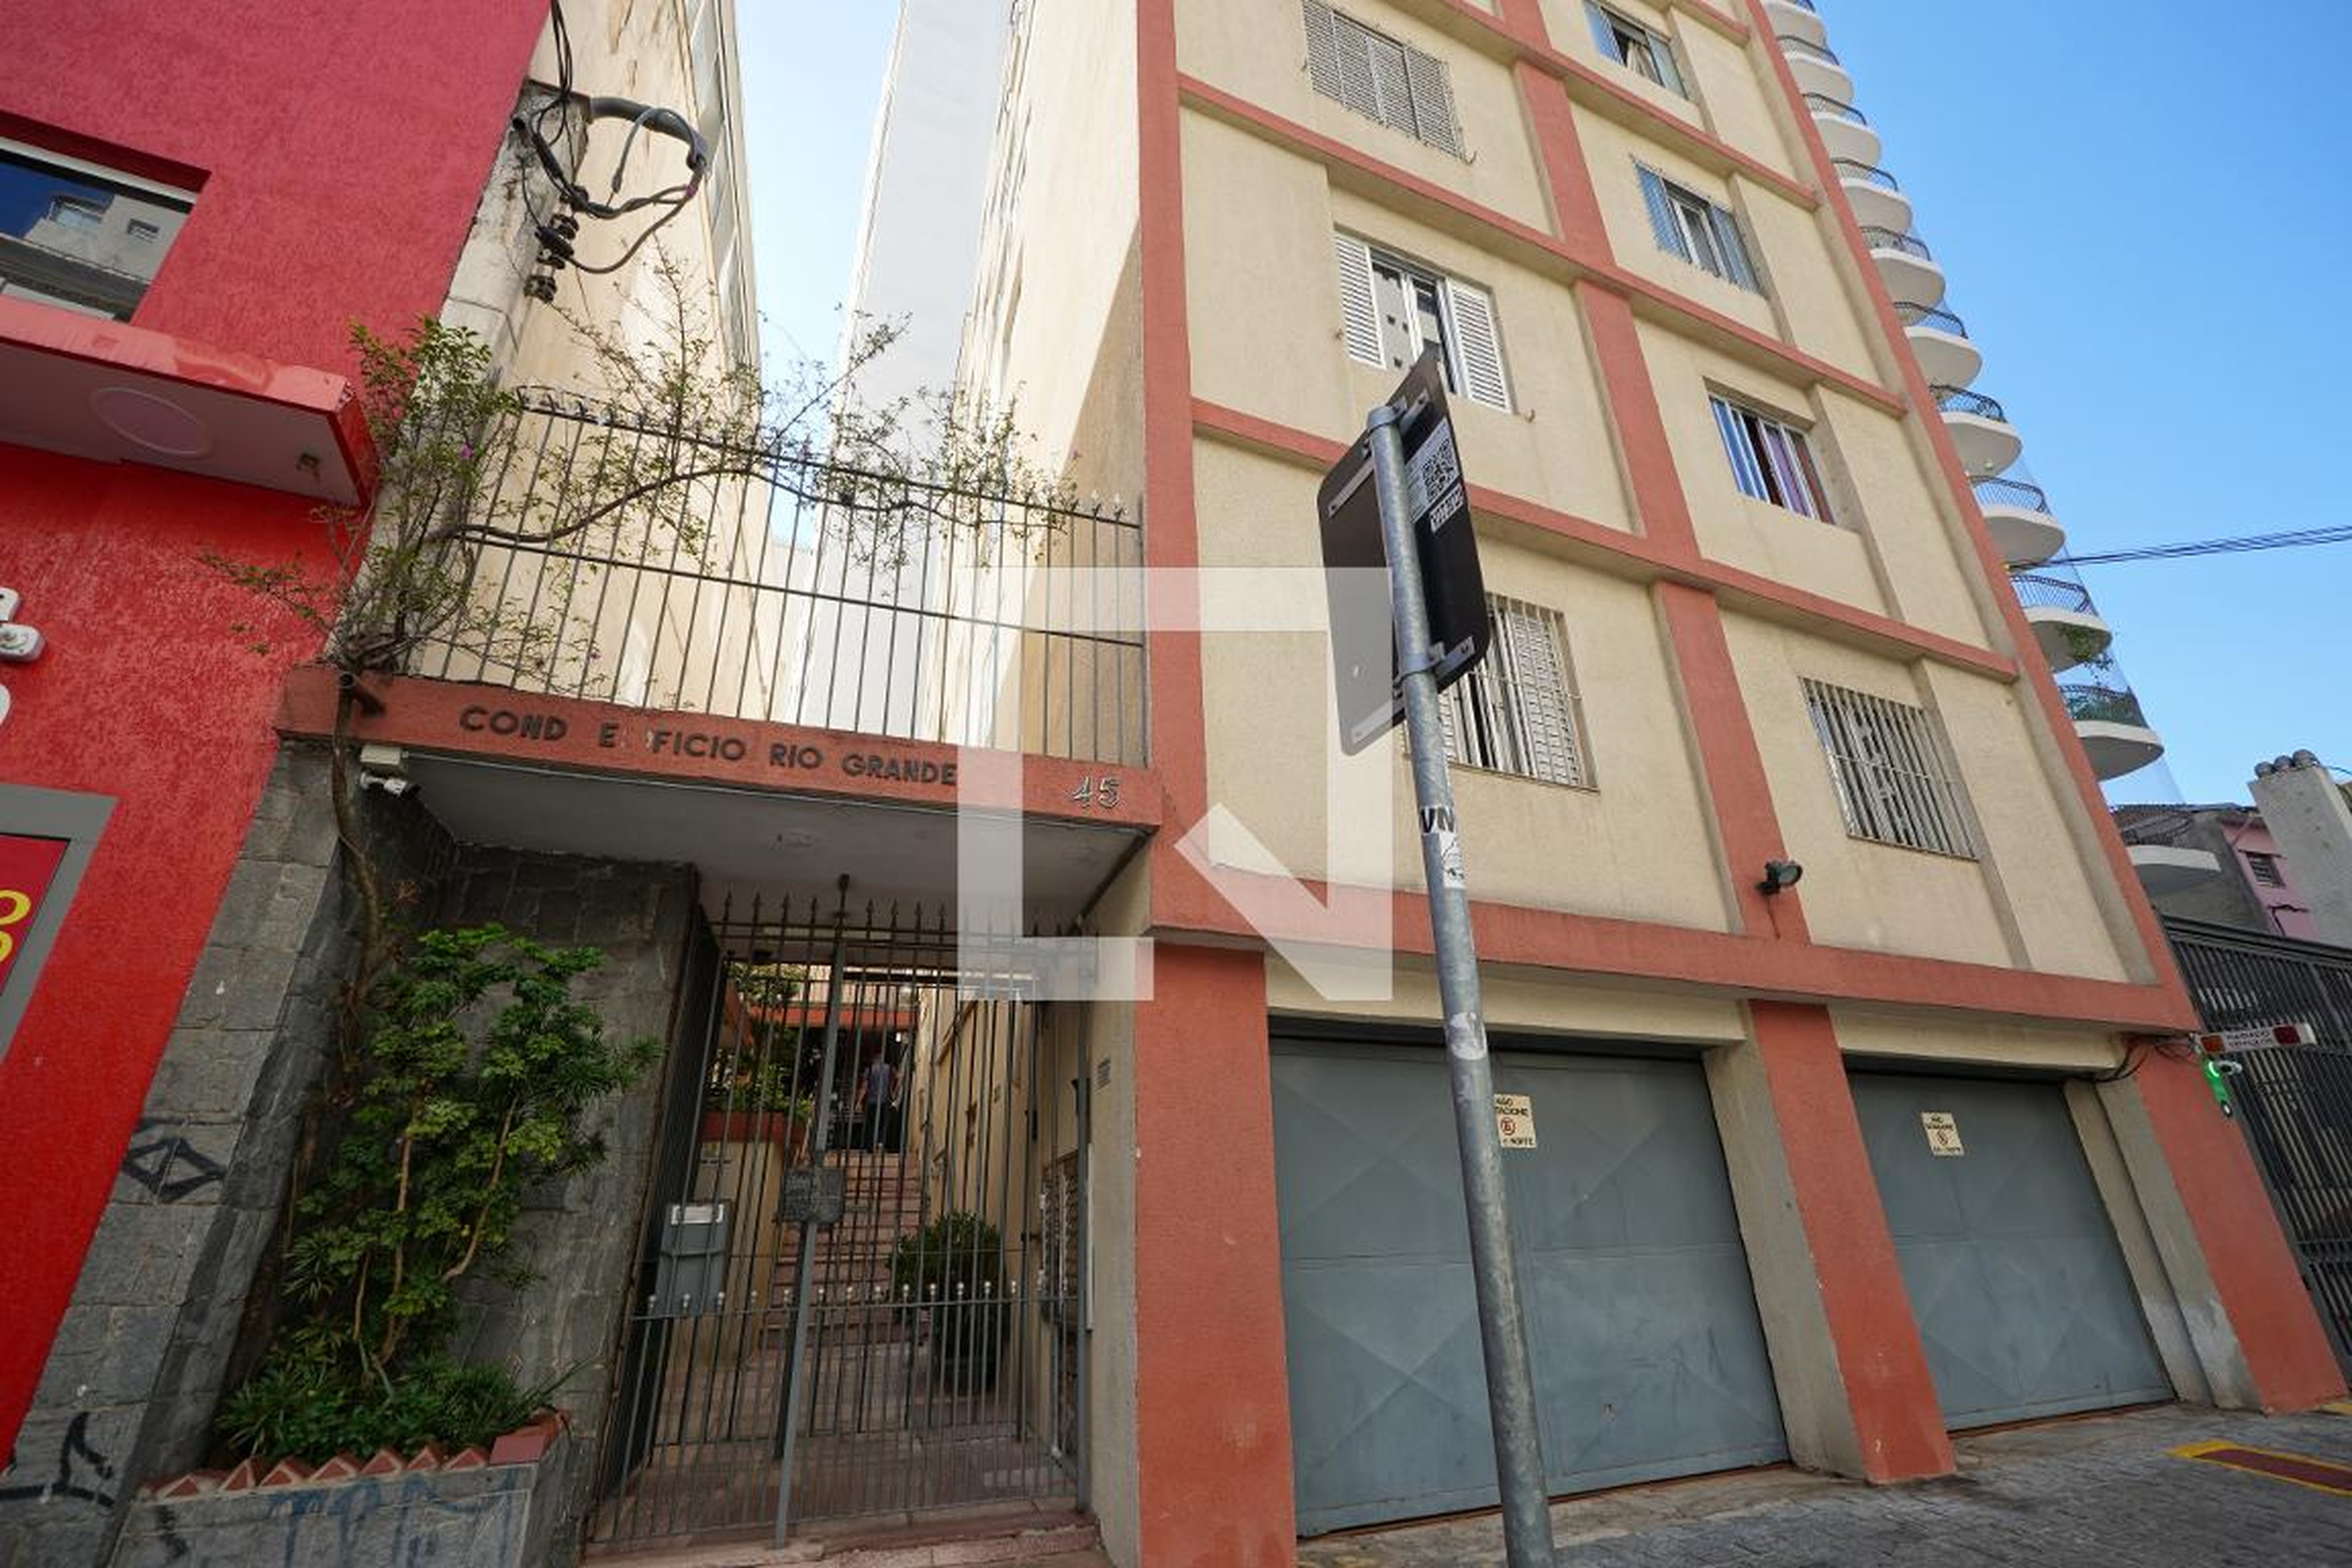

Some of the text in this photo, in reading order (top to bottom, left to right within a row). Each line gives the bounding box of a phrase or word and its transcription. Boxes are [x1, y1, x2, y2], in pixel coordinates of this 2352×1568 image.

[459, 704, 567, 741] COND
[769, 743, 823, 770] RIO
[842, 753, 957, 786] GRANDE
[1073, 776, 1120, 810] 45
